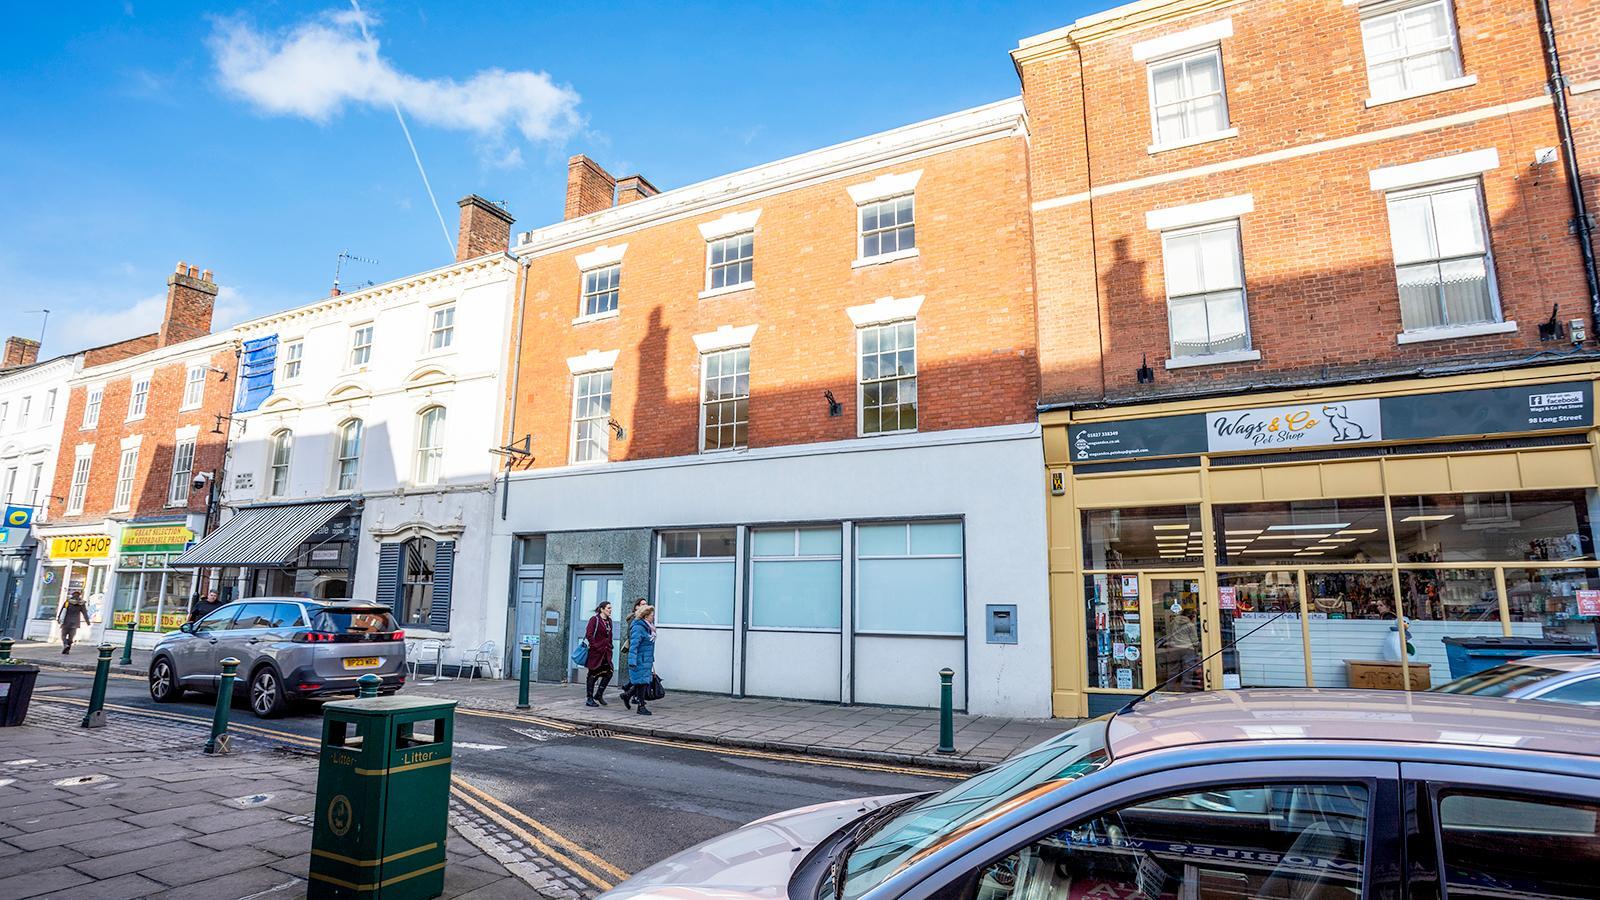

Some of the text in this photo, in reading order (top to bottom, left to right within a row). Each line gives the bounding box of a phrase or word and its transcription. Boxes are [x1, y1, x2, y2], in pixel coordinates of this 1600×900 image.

[1214, 410, 1319, 439] Wags & Co
[1252, 430, 1304, 446] Pet Shop
[153, 528, 181, 536] SELECTION
[65, 537, 111, 552] TOP SHOP
[332, 753, 354, 765] Litter
[402, 752, 433, 764] Litter
